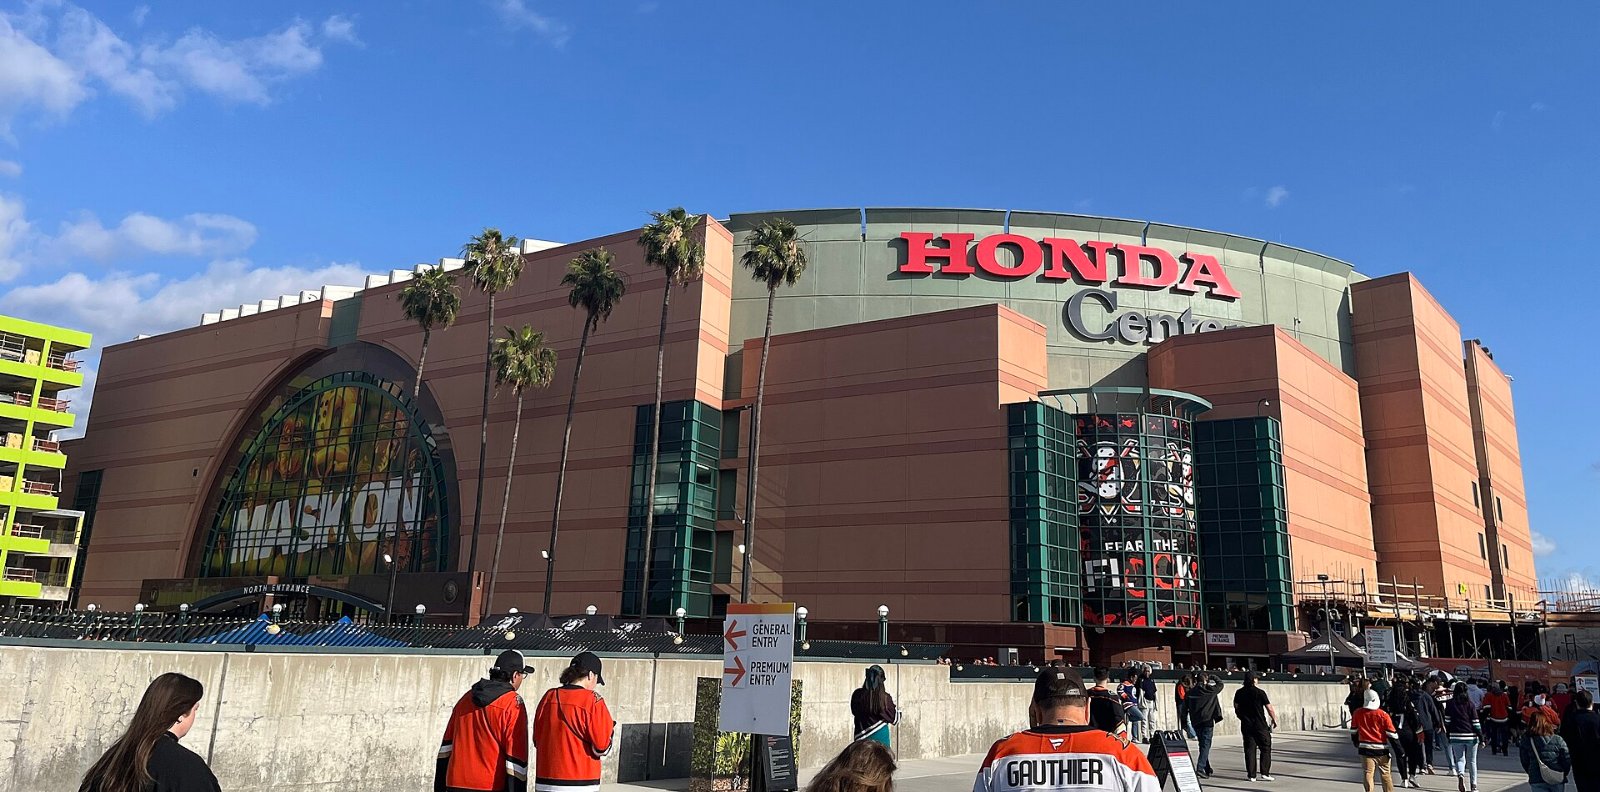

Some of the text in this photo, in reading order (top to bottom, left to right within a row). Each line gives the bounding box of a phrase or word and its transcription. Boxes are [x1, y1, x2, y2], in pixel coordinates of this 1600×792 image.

[900, 232, 1242, 299] HONDA
[1067, 288, 1246, 344] Cent
[230, 472, 424, 564] MASK ON
[1105, 538, 1179, 552] FEAR THE
[243, 584, 310, 594] NORTH ENTRANCE
[752, 624, 791, 635] GENERAL
[751, 637, 779, 648] ENTRY
[750, 661, 789, 674] PREMIUM
[749, 674, 777, 686] ENTRY
[1007, 759, 1103, 788] GAUTHIER
